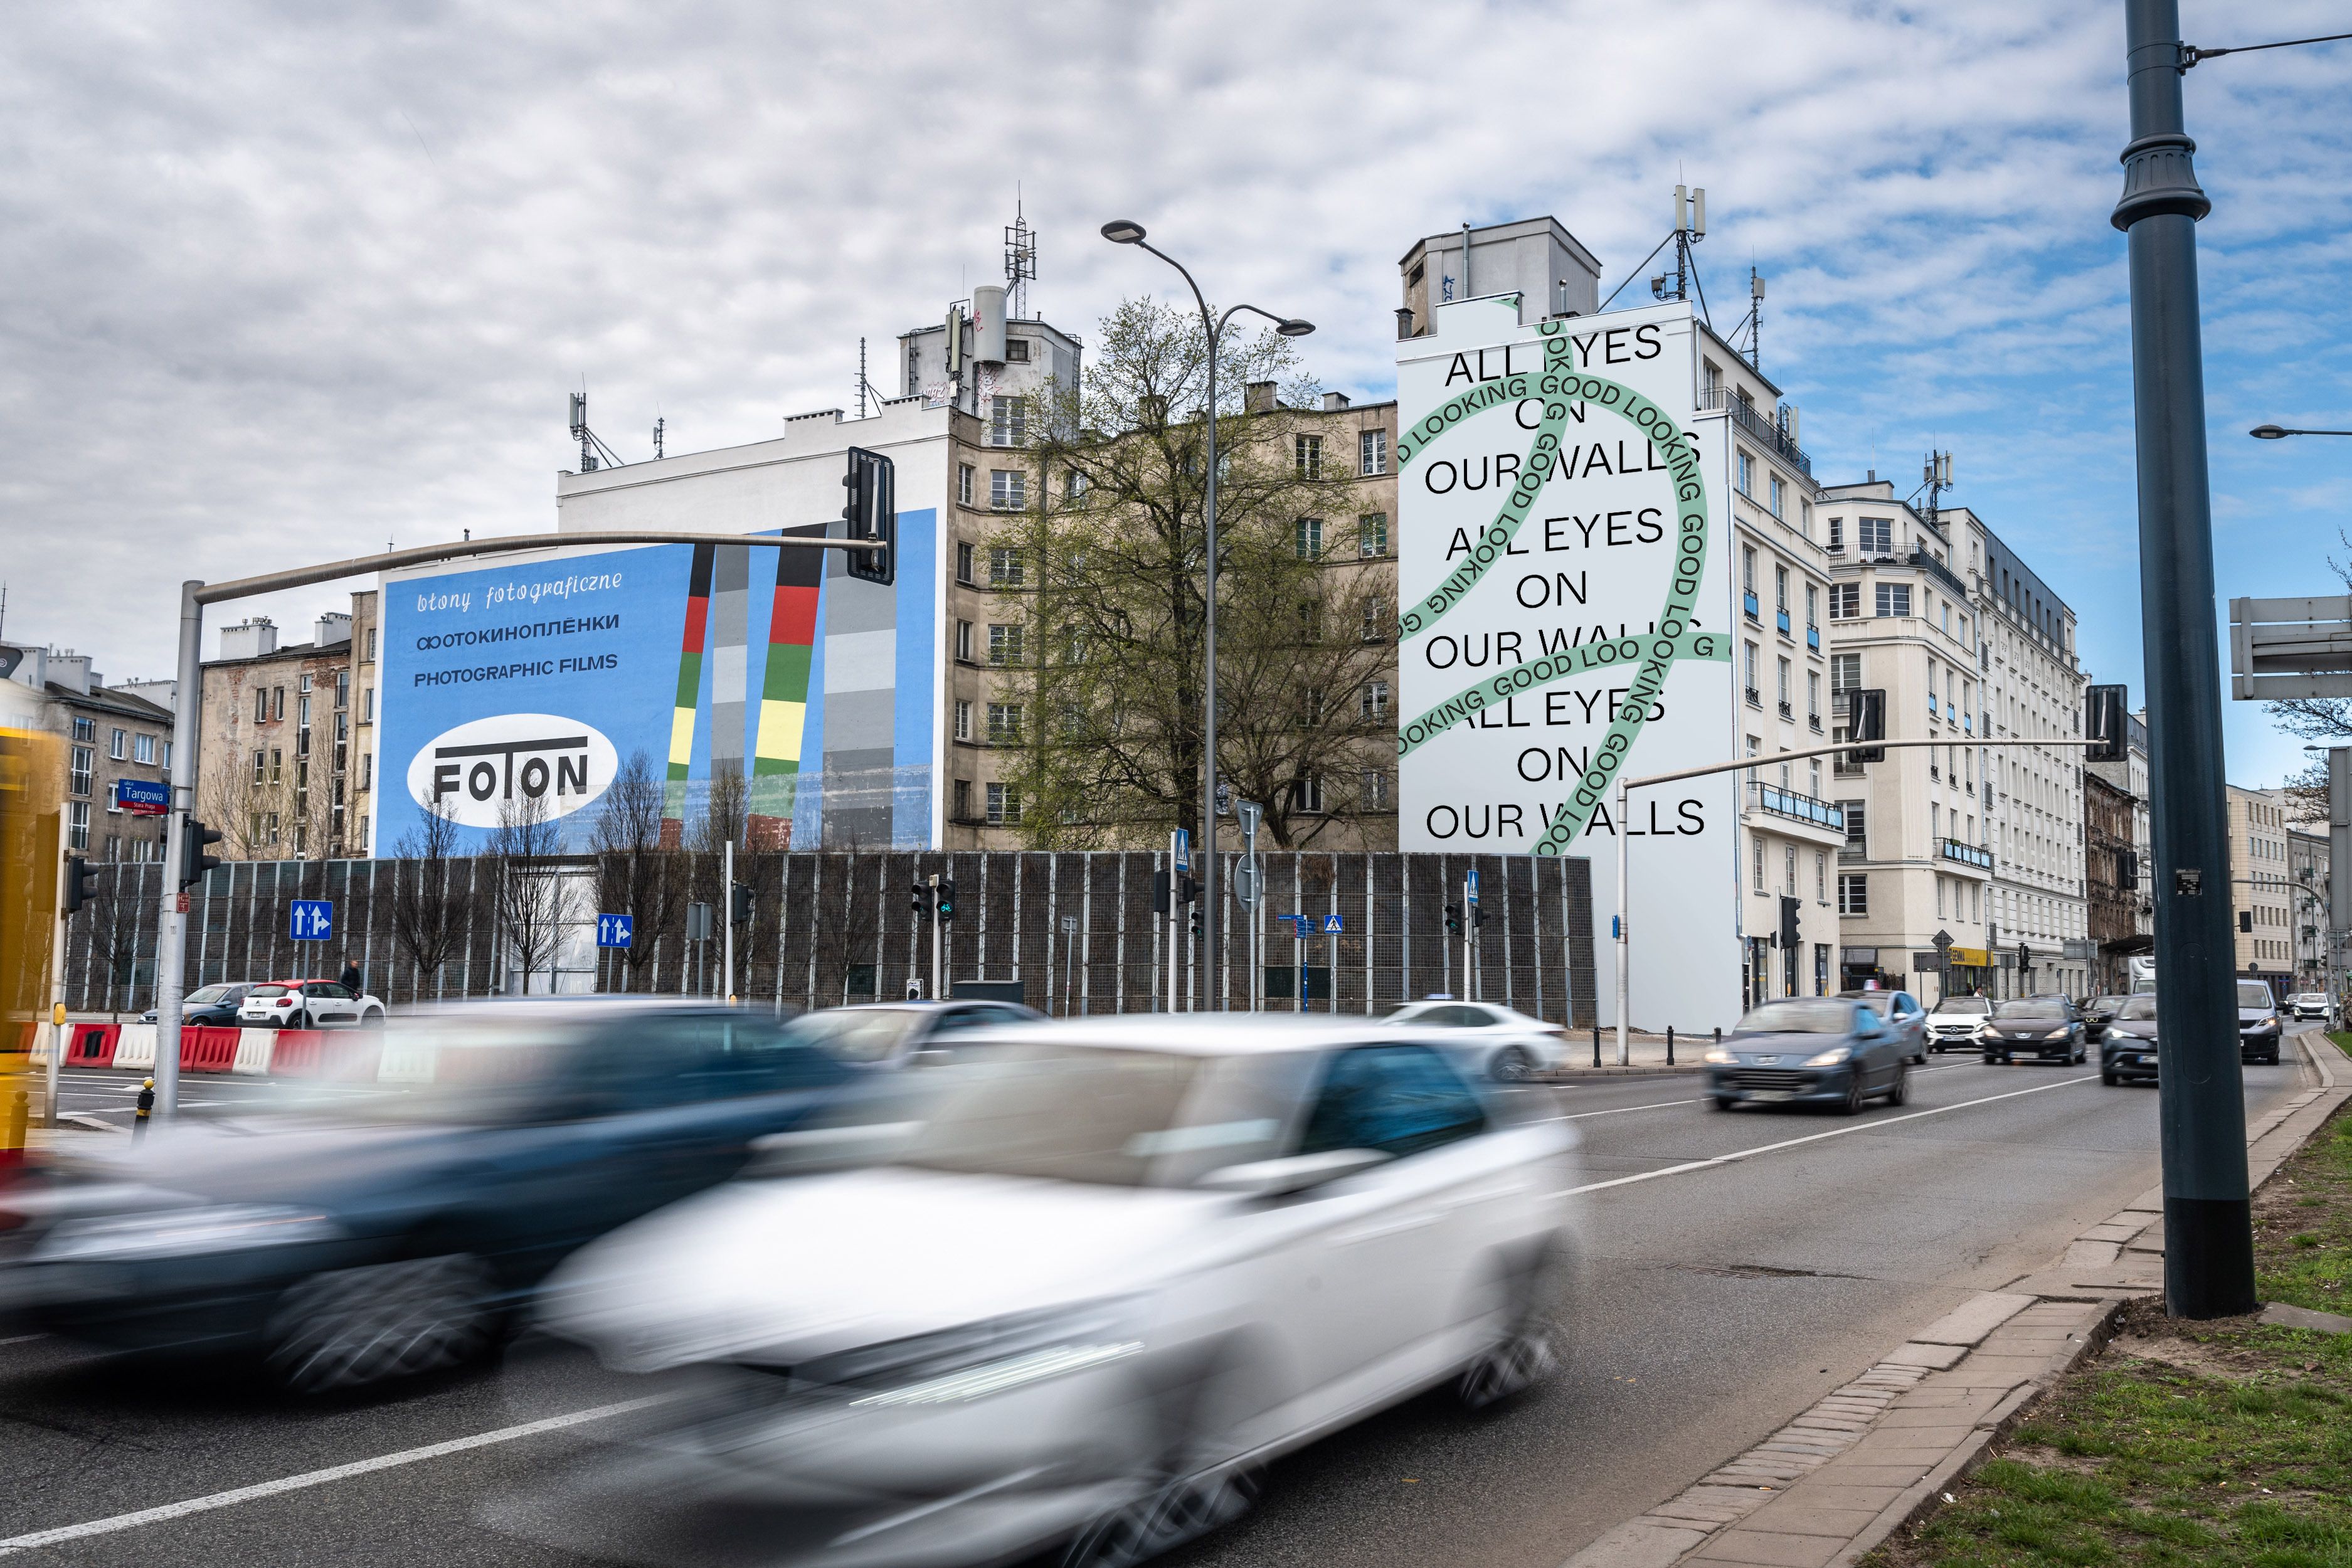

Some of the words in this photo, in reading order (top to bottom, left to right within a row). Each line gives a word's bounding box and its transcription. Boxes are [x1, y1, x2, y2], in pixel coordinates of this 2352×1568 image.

[1445, 346, 1528, 386] ALL
[1544, 324, 1661, 372] YES
[1540, 375, 1621, 405] GOOD
[1412, 378, 1527, 445] LOOKING
[1623, 396, 1701, 502] LOOKING
[1426, 453, 1521, 494] OUR
[1512, 433, 1558, 508] GOOD
[1446, 525, 1530, 561] AL
[1545, 507, 1663, 552] EYES
[1675, 514, 1704, 595] GOOD
[1426, 513, 1519, 613] LOOKING
[417, 591, 471, 612] błony
[486, 572, 622, 610] fotograficzne
[1517, 570, 1586, 608] ON
[414, 660, 554, 687] PHOTOGRAPHIC
[559, 653, 618, 673] FILMS
[1426, 631, 1523, 669] OUR
[1620, 604, 1690, 724] LOOKING
[1493, 655, 1572, 696] GOOD
[1446, 696, 1530, 730] LL
[433, 735, 588, 804] FOTON
[1517, 746, 1587, 782] ON
[1576, 733, 1628, 807] GOOD
[125, 787, 163, 802] Targowa
[1426, 804, 1524, 839] OUR
